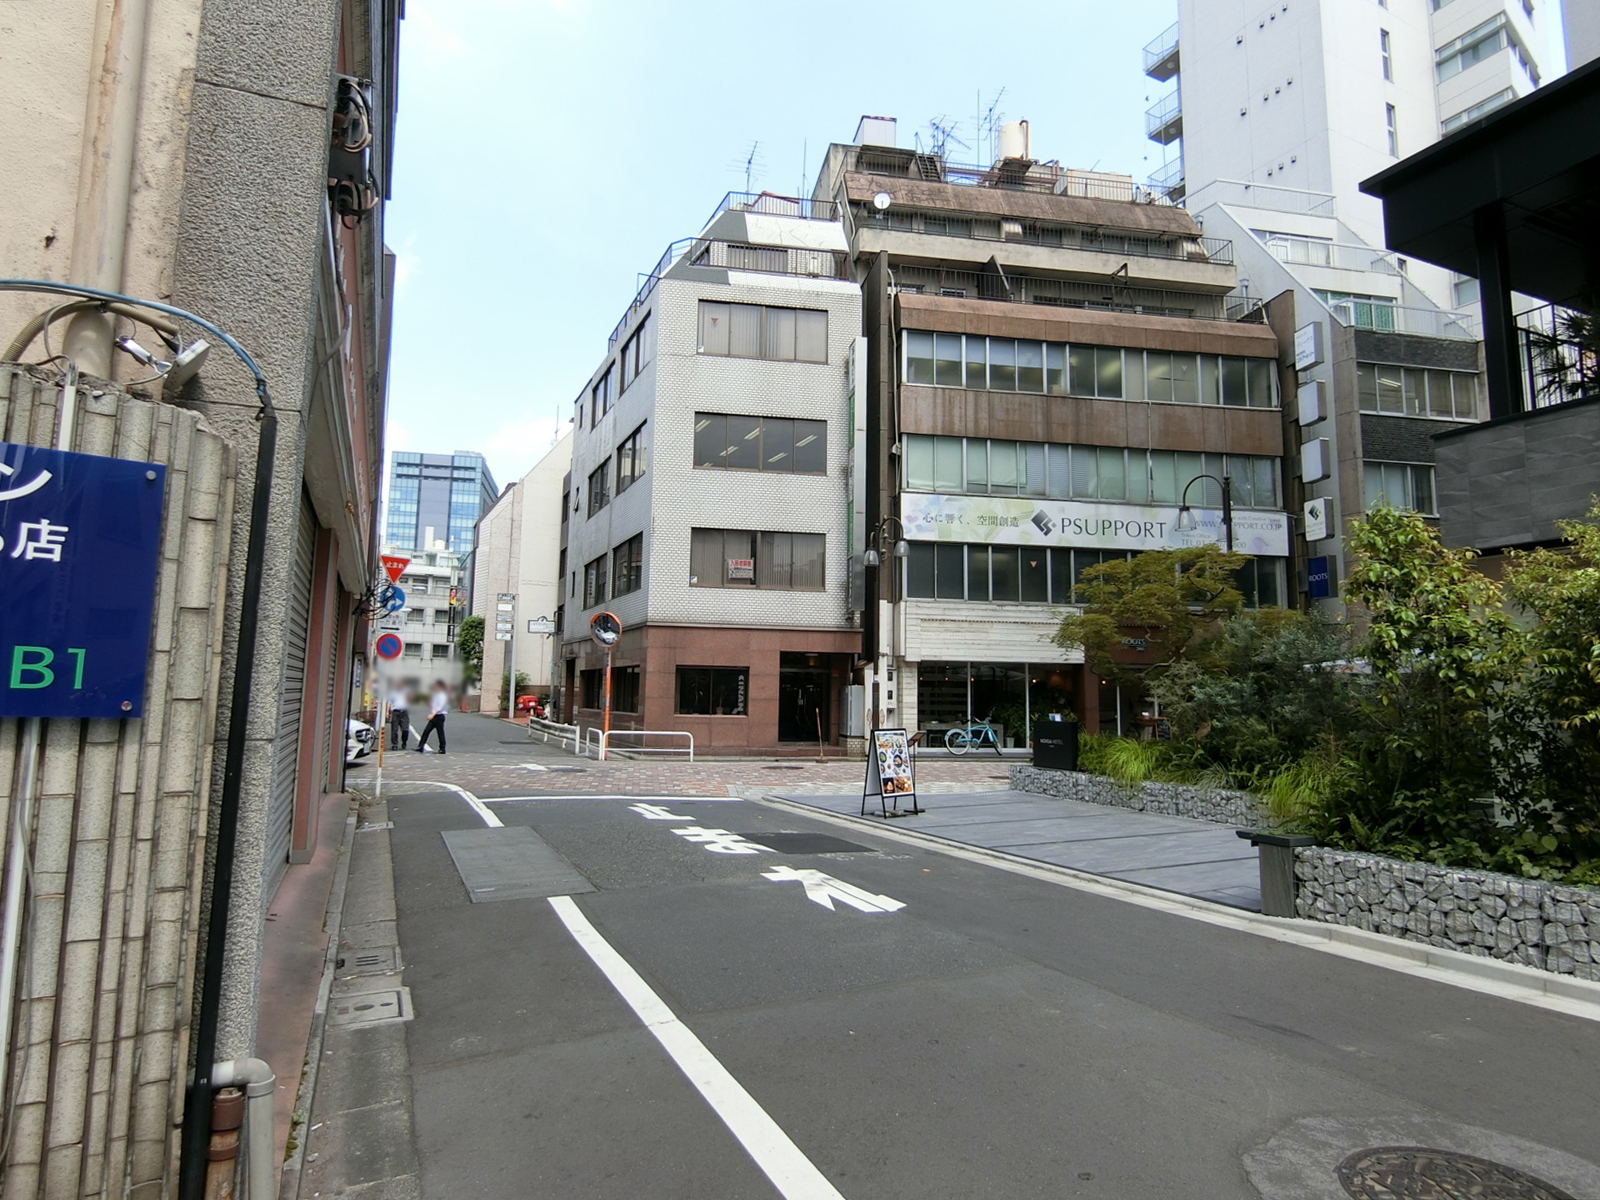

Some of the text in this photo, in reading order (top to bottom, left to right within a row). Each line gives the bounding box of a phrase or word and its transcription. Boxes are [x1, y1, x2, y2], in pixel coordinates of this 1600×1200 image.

[922, 512, 1020, 527] 心に響く、空間創造
[1060, 516, 1167, 539] PSUPPORT
[0, 519, 69, 562] 店
[386, 560, 405, 569] 止まれ
[1308, 572, 1328, 582] ROOTS
[10, 646, 86, 689] B1
[627, 803, 907, 912] 止まれ
